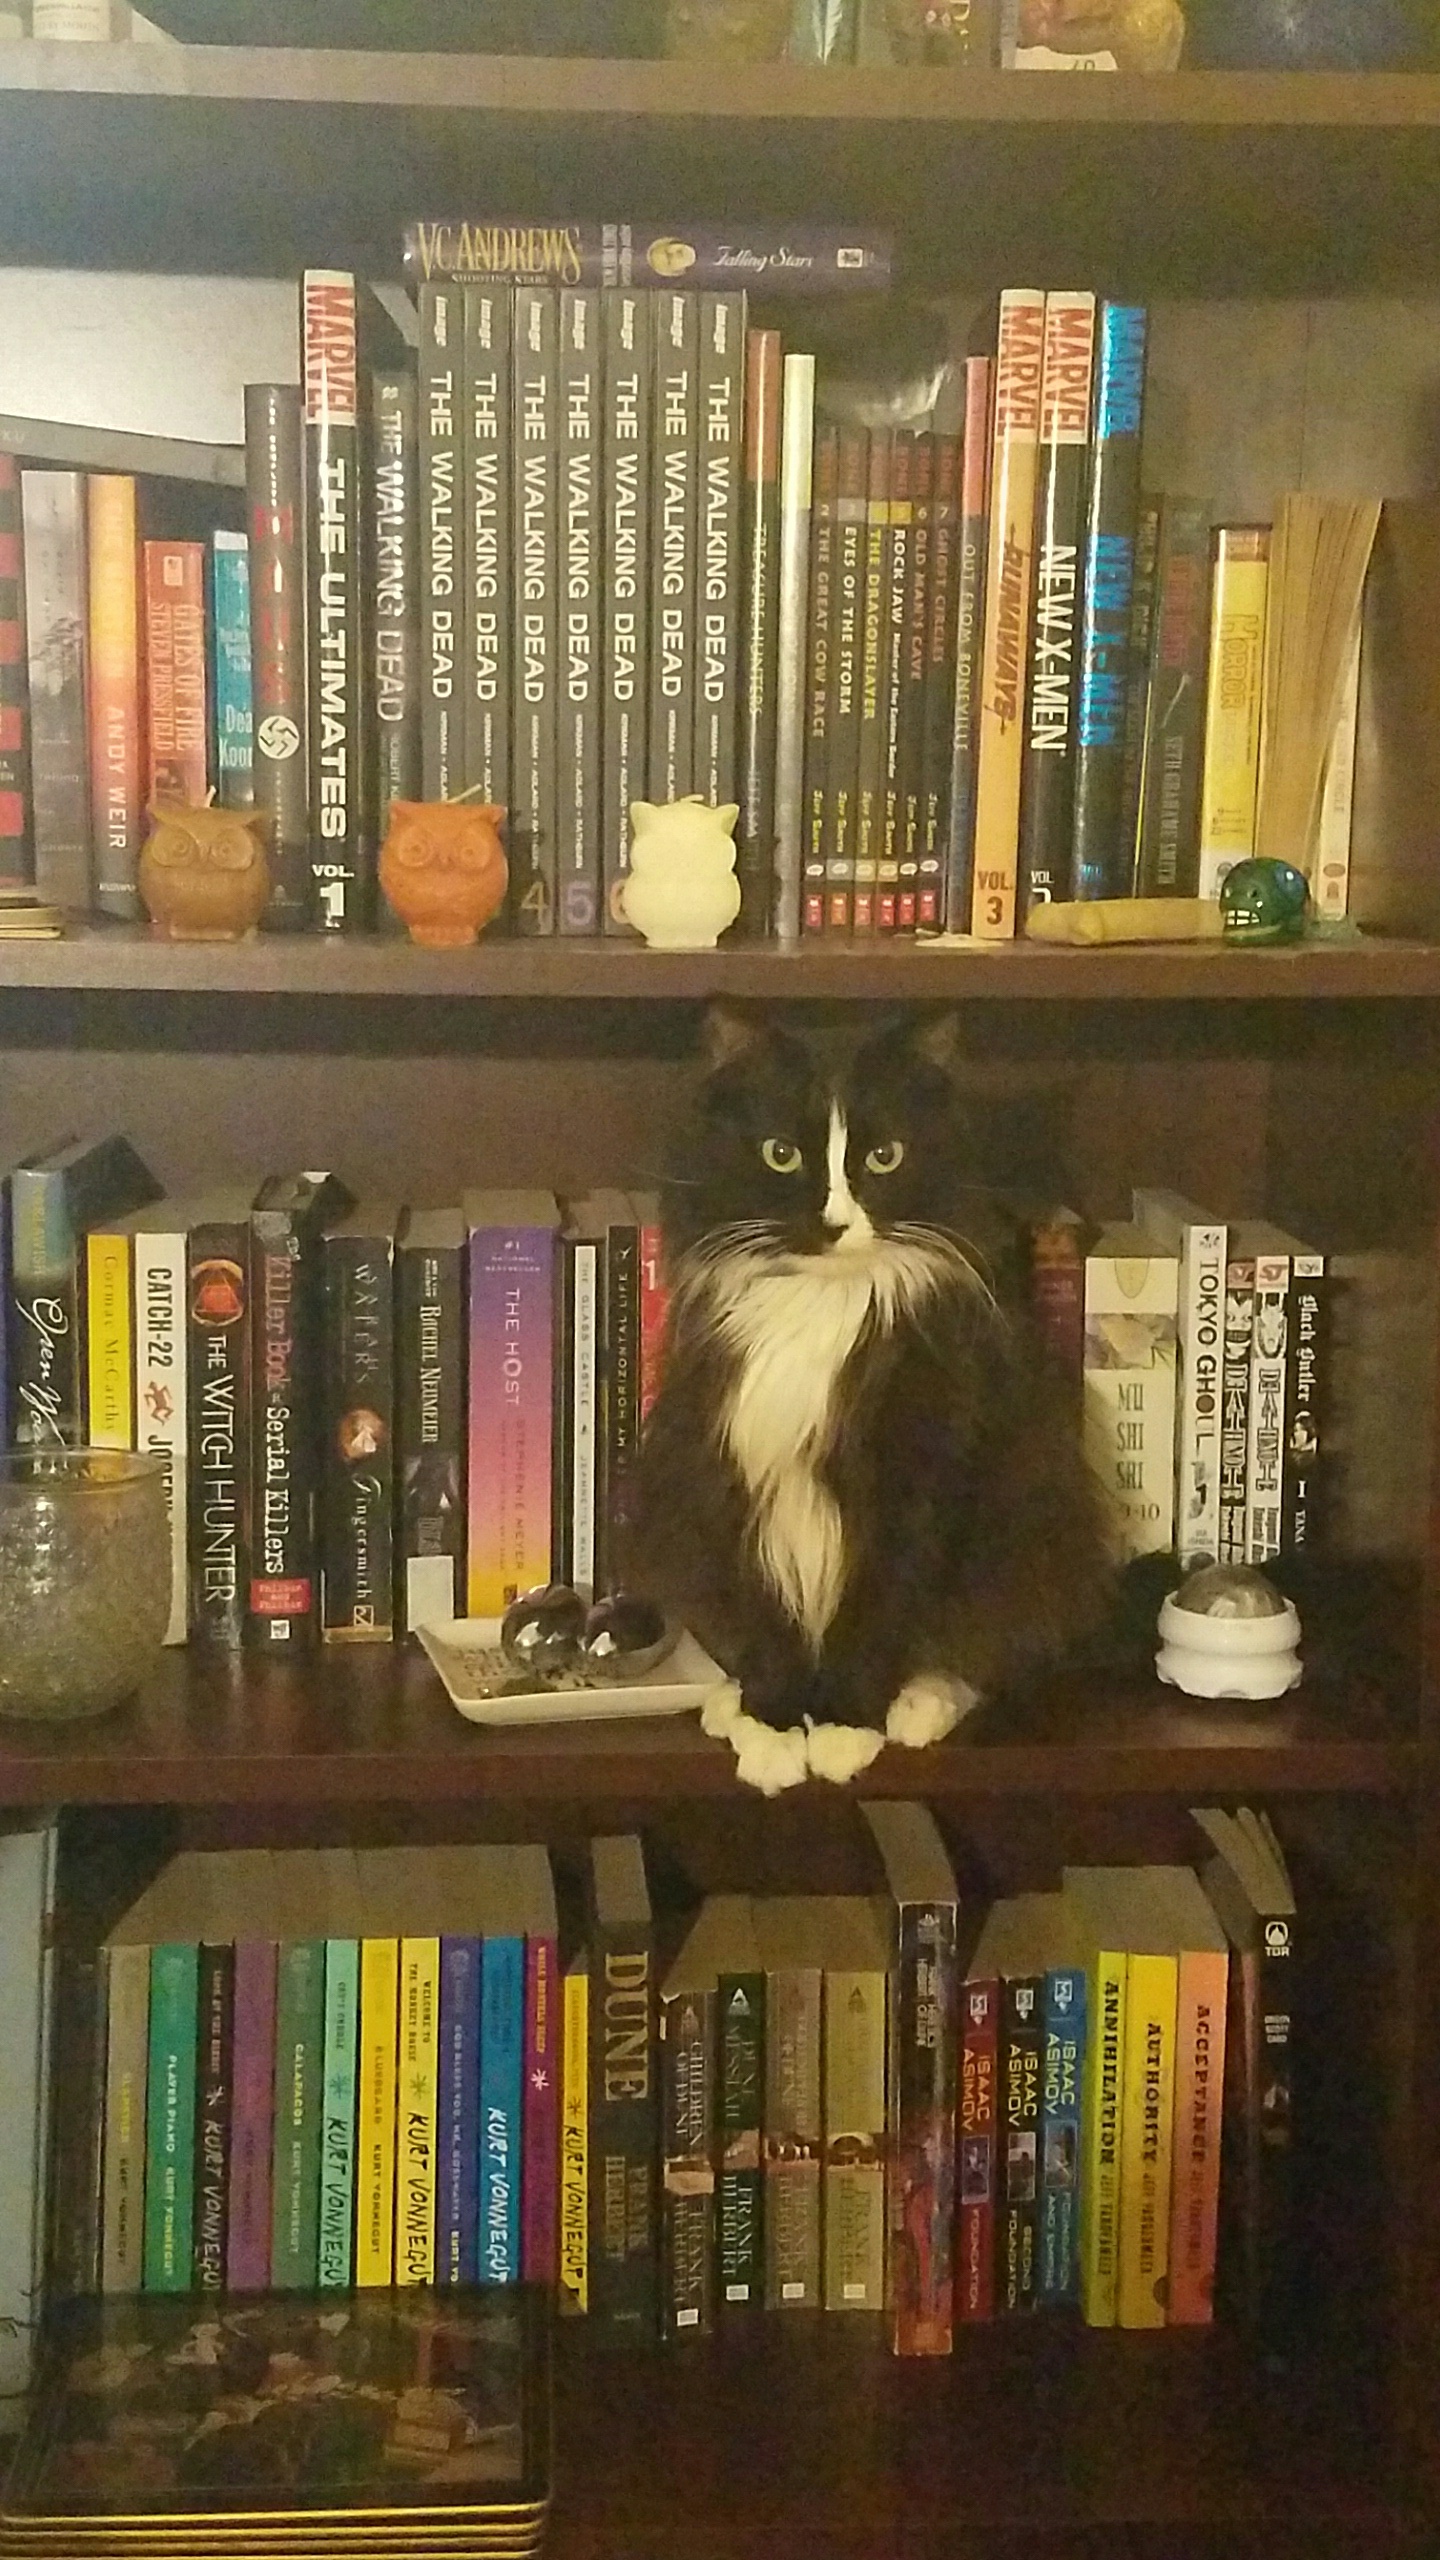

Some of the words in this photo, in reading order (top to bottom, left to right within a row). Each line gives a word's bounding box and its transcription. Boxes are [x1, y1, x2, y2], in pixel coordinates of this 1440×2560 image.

[457, 222, 582, 284] ANDREWS
[516, 273, 549, 284] STARS
[713, 246, 767, 272] Falling
[770, 246, 813, 267] Stars
[306, 283, 356, 424] MARVEL
[997, 305, 1045, 437] MARVEL
[1043, 308, 1093, 438] MARVEL
[1099, 307, 1147, 439] MARVEL
[430, 371, 453, 436] THE
[475, 373, 498, 439] THE
[524, 376, 547, 441] THE
[568, 374, 592, 440] THE
[616, 374, 639, 440] THE
[664, 370, 688, 436] THE
[708, 377, 731, 442] THE
[319, 459, 347, 555] THE
[430, 452, 454, 597] WALKING
[475, 454, 498, 599] WALKING
[524, 455, 547, 600] WALKING
[568, 454, 592, 599] WALKING
[615, 454, 639, 599] WALKING
[663, 450, 688, 595] WALKING
[706, 456, 731, 600] WALKING
[916, 506, 927, 520] 6
[818, 527, 831, 563] THE
[843, 527, 857, 568] EYES
[869, 529, 882, 565] THE
[914, 529, 928, 566] OLD
[962, 544, 977, 582] OUT
[816, 572, 830, 630] GREAT
[843, 574, 856, 600] OF
[912, 572, 926, 629] MAN'S
[958, 592, 975, 644] FROM
[1036, 545, 1077, 632] NEW
[152, 603, 174, 659] STEVEN
[174, 605, 202, 667] GATES
[432, 610, 455, 698] DEAD
[477, 612, 499, 701] DEAD
[525, 614, 547, 703] DEAD
[568, 614, 592, 702] DEAD
[614, 613, 637, 701] DEAD
[662, 609, 685, 697] DEAD
[705, 615, 727, 702] DEAD
[842, 608, 855, 643] THE
[864, 574, 881, 720] DRAGONSLAYER
[910, 636, 924, 681] CAVE
[932, 595, 946, 663] CIRCLES
[994, 540, 1030, 722] RUNAWAYS
[175, 675, 202, 700] OF
[814, 640, 828, 683] COW
[839, 651, 854, 715] STORM
[1030, 637, 1073, 748] X-MEN
[1220, 615, 1259, 712] HORROR
[152, 666, 175, 752] PRESSFIELD
[176, 707, 203, 752] FIRE
[318, 573, 347, 839] ULTIMATES
[813, 690, 828, 739] RACE
[955, 653, 972, 751] BONEVILLE
[108, 706, 127, 774] ANDY
[109, 787, 128, 849] WEIR
[314, 865, 355, 881] VOL.
[320, 882, 348, 928] 1
[567, 881, 593, 926] 5
[520, 882, 552, 934] 4
[987, 897, 1004, 926] 3
[102, 1256, 119, 1330] Cormac
[148, 1267, 174, 1368] CATCH-22
[265, 1256, 292, 1336] Killer
[354, 1263, 370, 1384] WATERS
[504, 1288, 521, 1332] THE
[618, 1272, 630, 1308] LIFE
[1195, 1257, 1221, 1346] TOKYO
[1298, 1294, 1319, 1341] Black
[15, 1298, 69, 1380] Open
[207, 1335, 227, 1370] THE
[265, 1339, 291, 1391] Book
[420, 1305, 442, 1362] RACHEL
[104, 1339, 121, 1432] McCarthy
[502, 1341, 523, 1408] HOST
[616, 1315, 628, 1420] HORIZONTAL
[1117, 1384, 1144, 1413] MU
[1295, 1347, 1318, 1402] Butler
[200, 1373, 236, 1469] WITCH
[420, 1367, 442, 1443] NEUMEIER
[1116, 1421, 1145, 1451] SHI
[1194, 1354, 1218, 1455] GHOUL
[266, 1407, 290, 1484] Serial
[204, 1480, 237, 1603] HUNTER
[264, 1488, 289, 1574] Killers
[351, 1472, 382, 1599] Fingersmith
[514, 1517, 526, 1570] MEYER
[1294, 1509, 1307, 1544] YANA
[408, 1962, 418, 1982] THE
[1265, 1946, 1290, 1957] TOR
[408, 1987, 418, 2027] MONKEY
[421, 2031, 431, 2044] TO
[422, 1979, 432, 2029] WELCOME
[604, 1951, 650, 2102] DUNE
[407, 2031, 417, 2062] HOUSE
[675, 2052, 690, 2079] OF
[1044, 2032, 1060, 2116] ASIMOV
[1060, 2040, 1077, 2106] ISAAC
[1100, 1981, 1119, 2165] ANNIHILATION
[166, 2055, 179, 2106] PLAYER
[292, 2043, 306, 2127] GALAPAGOS
[675, 2082, 689, 2140] DUNE
[688, 2040, 703, 2146] CHILDREN
[962, 2048, 977, 2132] ASIMOV
[977, 2055, 991, 2122] ISAAC
[1007, 2043, 1023, 2127] ASIMOV
[1023, 2050, 1038, 2117] ISAAC
[1142, 2022, 1162, 2165] AUTHORITY
[1191, 2004, 1211, 2164] ACCEPTANCE
[165, 2109, 178, 2153] PIANO
[203, 2119, 224, 2177] KURT
[372, 2143, 383, 2178] KURT
[407, 2111, 431, 2171] KURT
[486, 2107, 508, 2166] KURT
[563, 2125, 585, 2175] KURT
[164, 2166, 176, 2201] KURT
[605, 2156, 627, 2262] HERBERT
[627, 2166, 650, 2250] FRANK
[1045, 2194, 1057, 2226] AND
[162, 2206, 175, 2277] VONNEGUT
[371, 2182, 382, 2255] VONNEGUT
[402, 2177, 431, 2287] VONNEGUT
[450, 2229, 460, 2263] KURT
[485, 2171, 511, 2284] VONNEGUT
[562, 2181, 587, 2280] VONNEGUT
[687, 2211, 703, 2292] FRANK
[721, 2175, 738, 2277] HERBERT
[736, 2185, 754, 2267] FRANK
[1059, 2191, 1072, 2290] FOUNDATION
[673, 2201, 688, 2305] HERBERT
[969, 2208, 982, 2309] FOUNDATION
[1007, 2209, 1018, 2309] FOUNDATION
[1021, 2226, 1033, 2291] SECOND
[1044, 2232, 1057, 2290] EMPIRE
